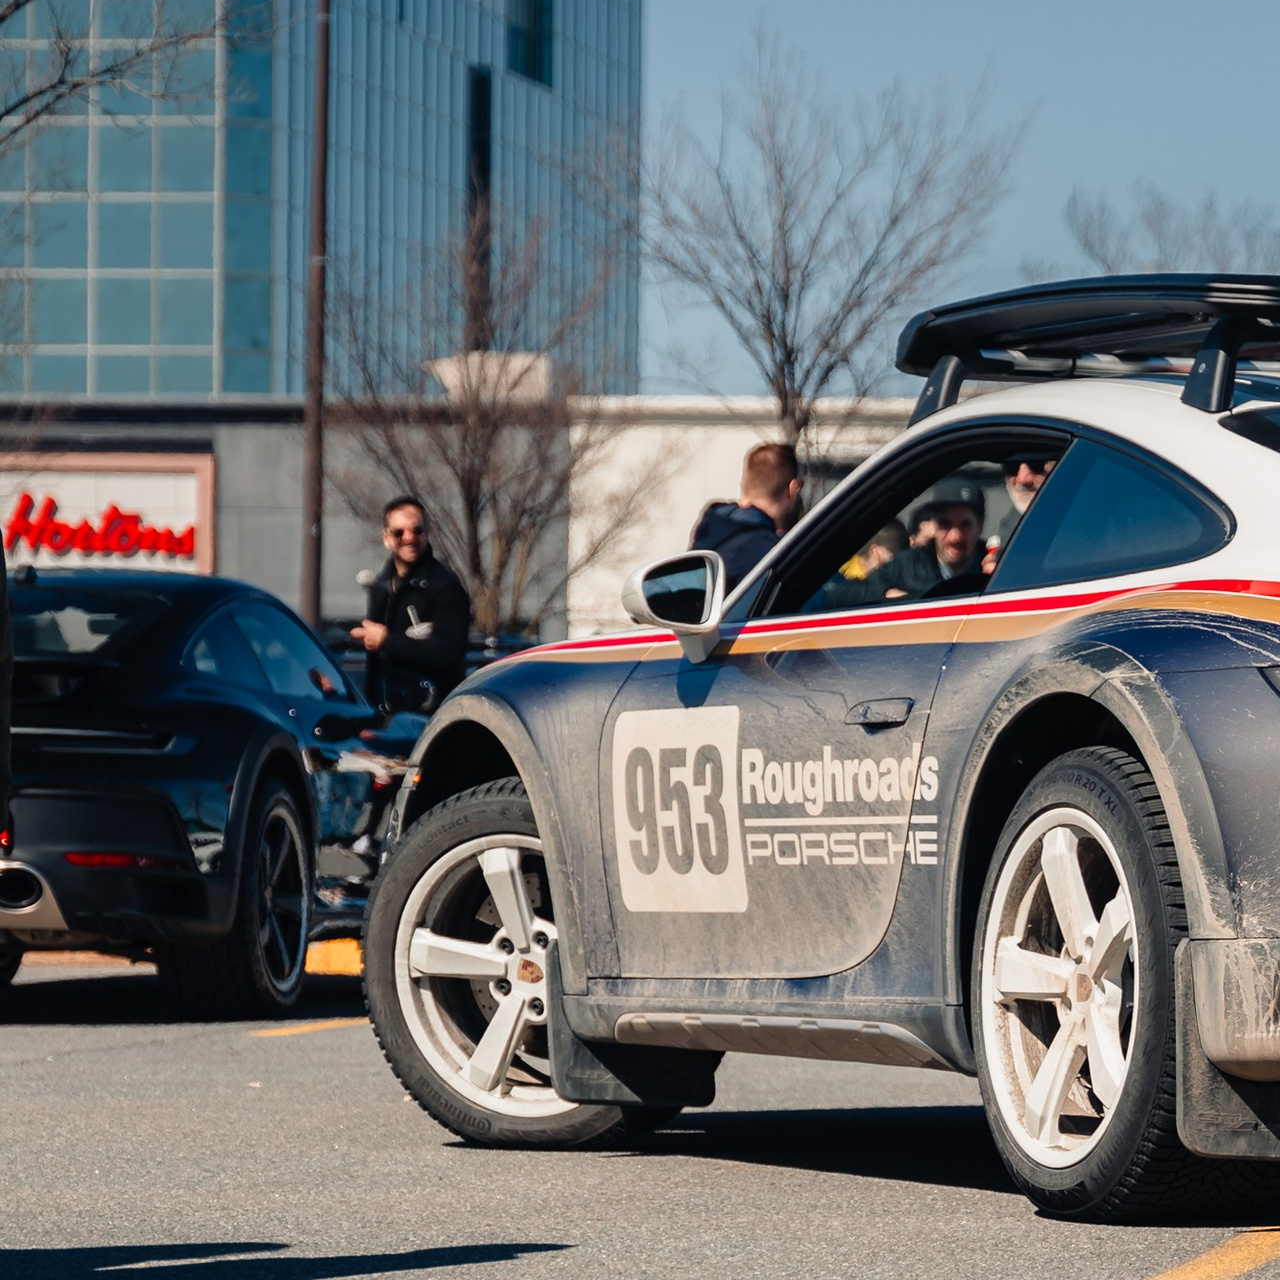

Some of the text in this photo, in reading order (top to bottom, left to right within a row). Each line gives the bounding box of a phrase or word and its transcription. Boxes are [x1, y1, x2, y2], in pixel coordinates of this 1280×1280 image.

[5, 492, 195, 555] Hortons
[624, 744, 730, 875] 953
[741, 742, 939, 816] Roughroads
[746, 831, 938, 865] PORSCHE
